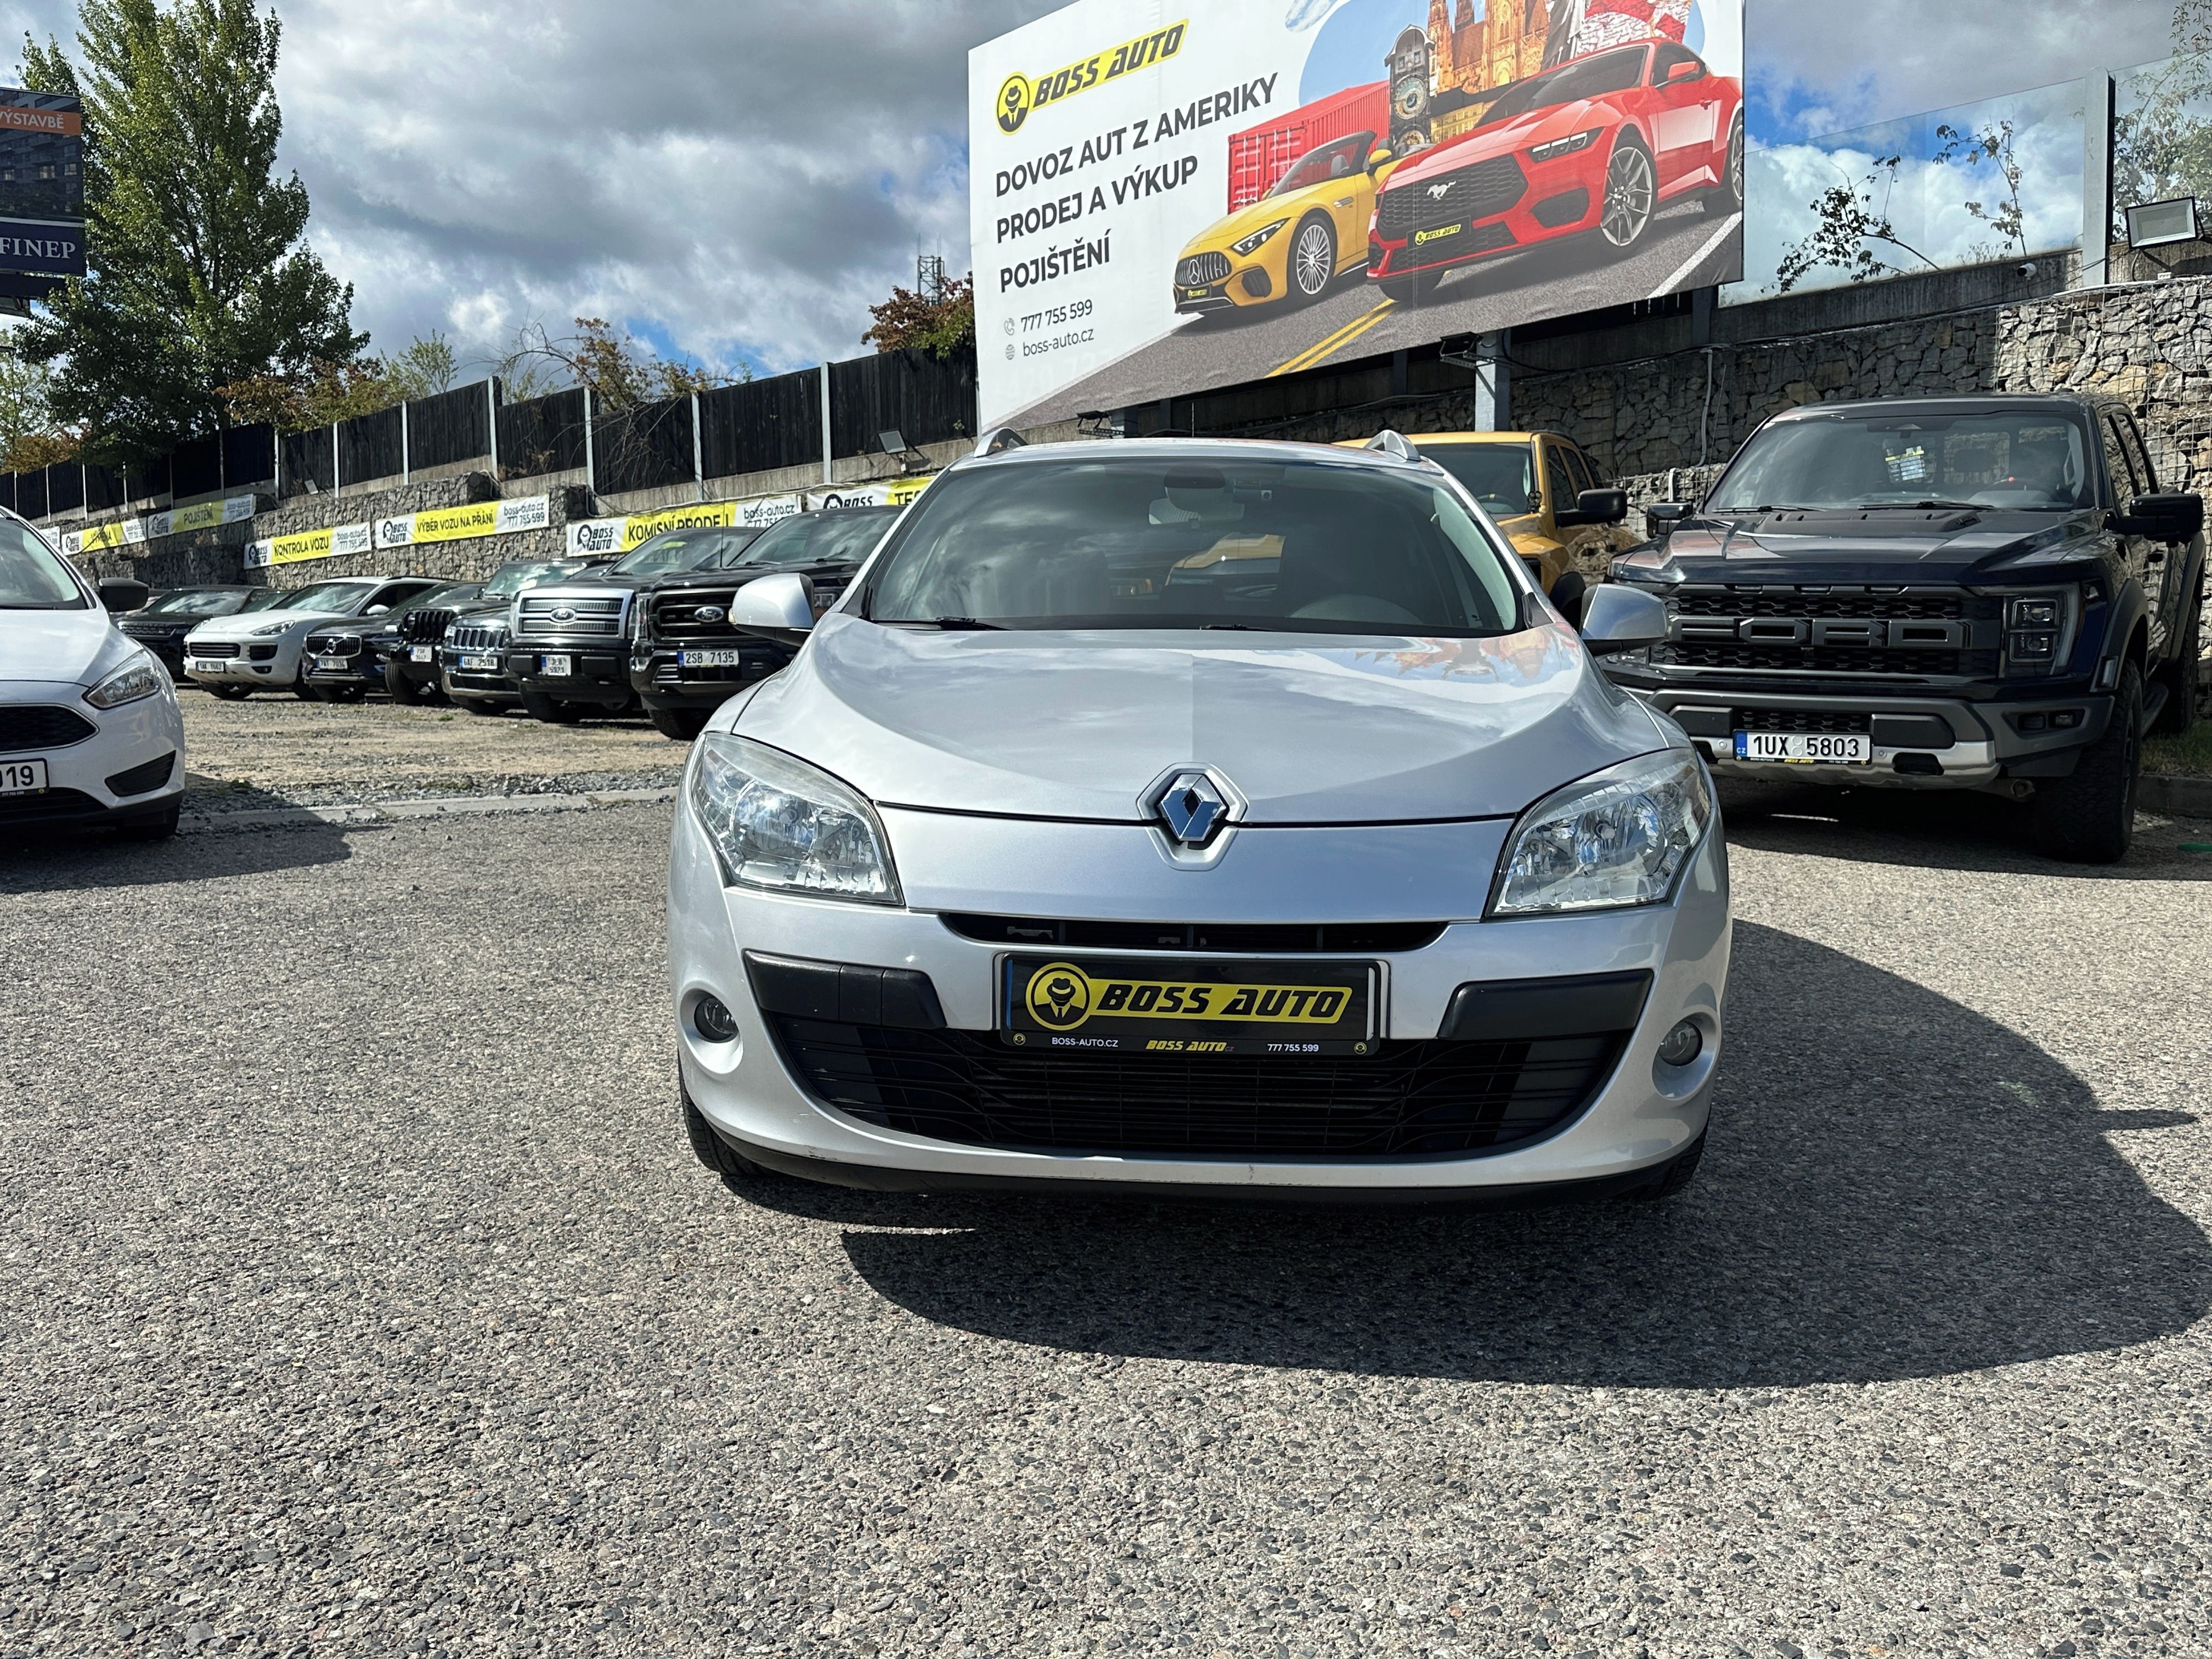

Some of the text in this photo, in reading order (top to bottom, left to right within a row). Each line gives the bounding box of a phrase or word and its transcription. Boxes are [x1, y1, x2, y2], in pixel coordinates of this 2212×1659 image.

[1033, 24, 1184, 108] BOSS AUTO
[996, 72, 1277, 197] DOVOZ AUT Z AMERIKY
[997, 155, 1198, 243] PRODEJ A VÝKUP
[0, 237, 76, 258] FINEP
[1000, 229, 1110, 293] POJIŠTĚNÍ
[1021, 299, 1092, 332] 777 755 599
[1023, 329, 1094, 356] boss-auto.cz
[504, 501, 544, 516] boss-auto.cz
[744, 505, 794, 520] boss-auto.cz
[393, 523, 408, 532] BOSS
[417, 510, 494, 533] VÝBĚR VOZU NA PŘÁNÍ
[507, 512, 545, 527] 777 755 599
[629, 515, 675, 541] KOMISNÍ
[390, 533, 406, 543] AUTO
[592, 527, 613, 539] BOSS
[274, 537, 329, 556] KONTROLA VOZU
[589, 539, 612, 550] AUTO
[686, 652, 734, 664] 2SB 7135
[1753, 736, 1788, 756] 1UX
[1807, 737, 1859, 757] 5803
[0, 765, 34, 788] 19
[1097, 984, 1346, 1018] BOSS AUTO
[1052, 1037, 1118, 1047] BOSS-AUTO.CZ
[1146, 1040, 1184, 1051] BOSS
[1186, 1041, 1227, 1052] AUTO
[1267, 1043, 1282, 1052] 777
[1302, 1044, 1319, 1052] 599
